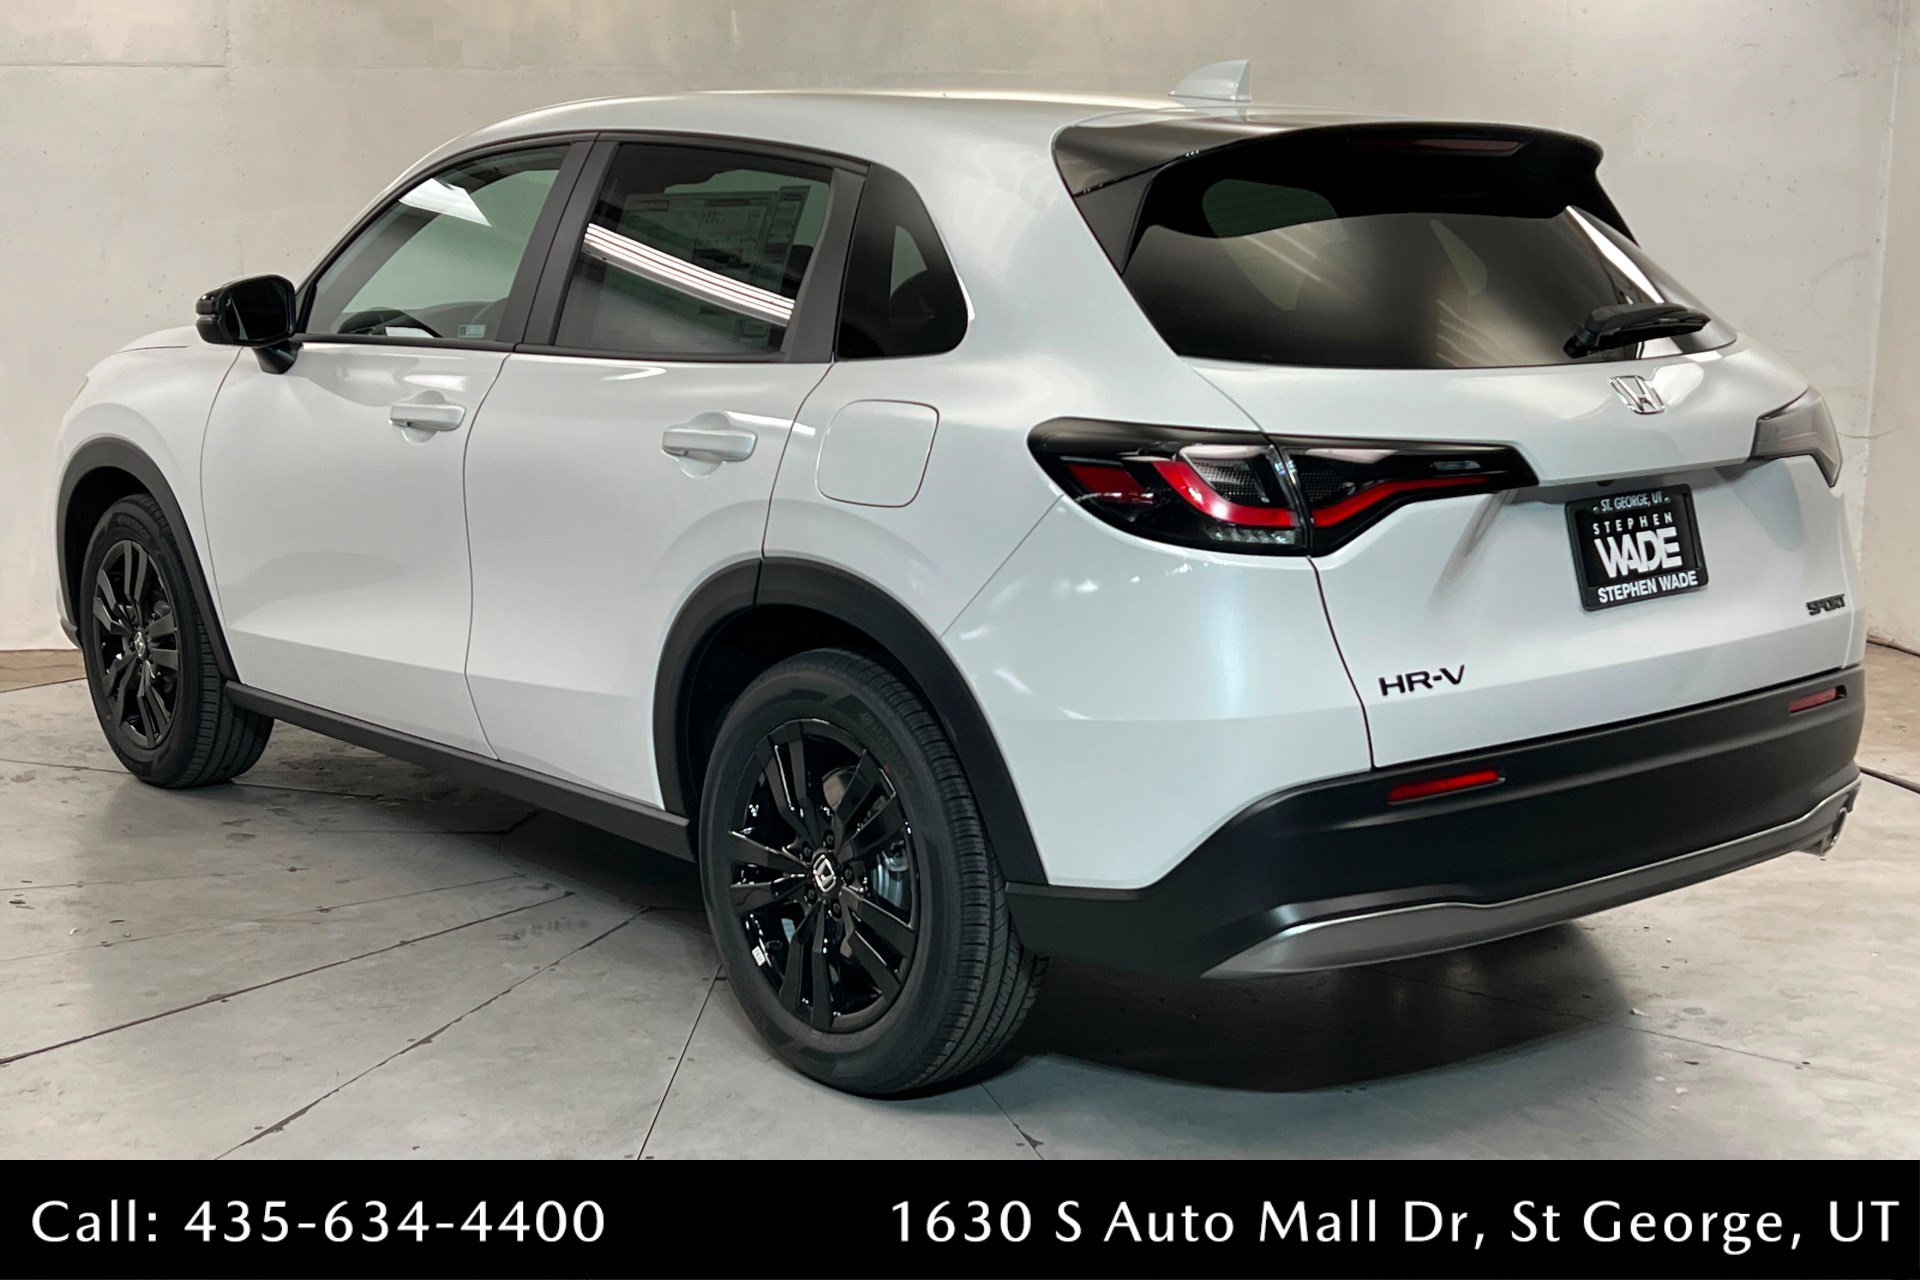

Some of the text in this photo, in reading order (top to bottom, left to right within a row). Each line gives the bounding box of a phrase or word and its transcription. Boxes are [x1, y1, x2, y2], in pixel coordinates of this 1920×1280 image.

[1614, 494, 1651, 509] GEORGE,
[1651, 491, 1662, 504] UT
[1593, 512, 1673, 535] STEPHEN
[1594, 526, 1683, 578] WADE
[1597, 570, 1698, 603] STEPHEN WADE
[1378, 664, 1465, 697] HR-V
